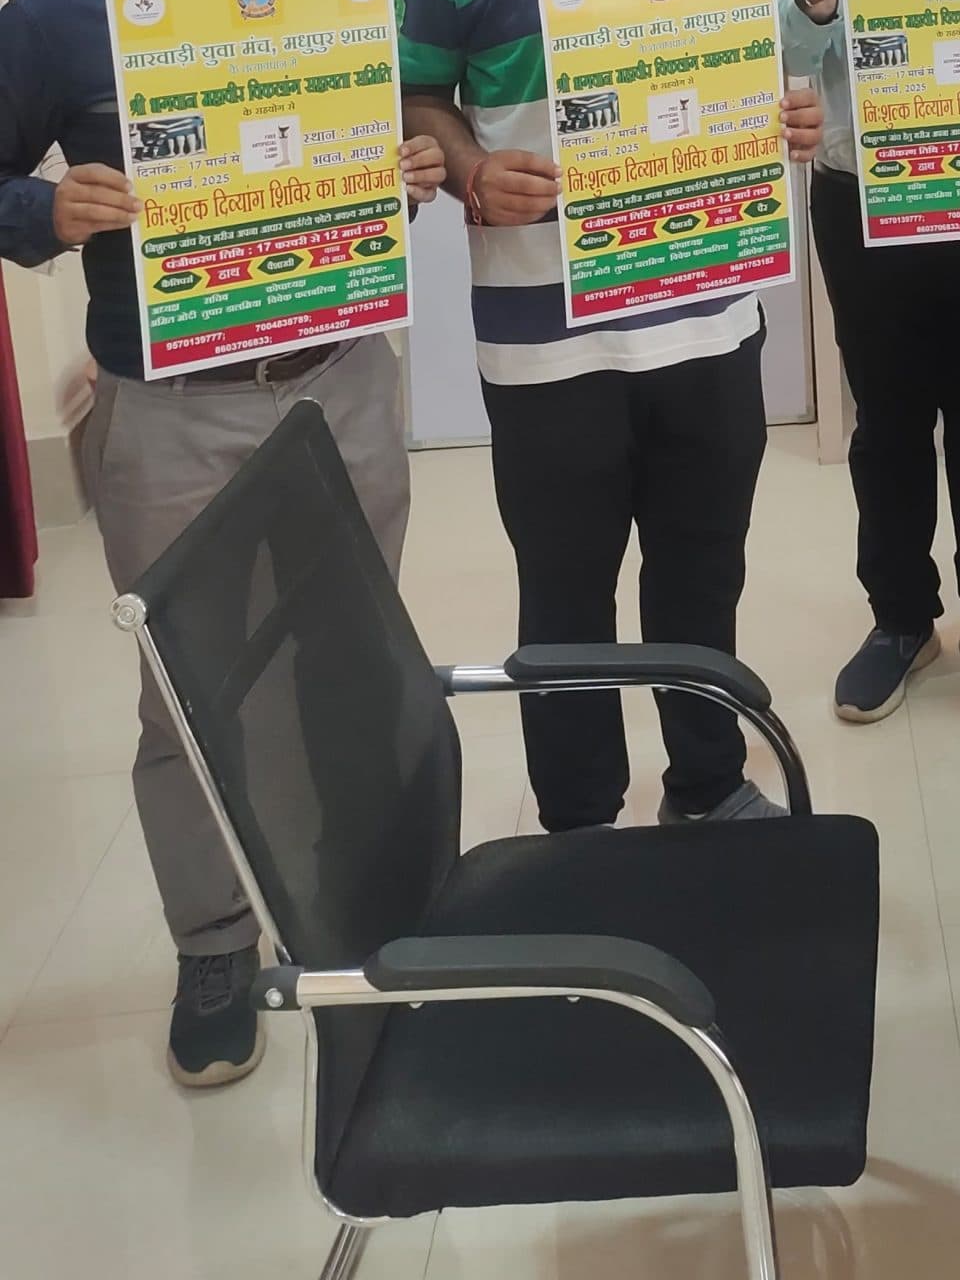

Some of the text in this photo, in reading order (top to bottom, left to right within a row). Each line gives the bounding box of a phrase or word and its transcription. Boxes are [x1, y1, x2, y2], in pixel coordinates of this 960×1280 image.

[551, 4, 773, 52] मारवाड़ी युवा मंच, मधुपुर शाखा
[123, 24, 387, 69] मारवाड़ी युवा मंच, मधुपुर शाखा
[303, 129, 335, 143] स्थान
[349, 119, 390, 137] अग्रसेन
[311, 144, 384, 165] भवन, मधुपुर
[575, 142, 639, 162] 19 मार्च, 2025
[623, 152, 668, 183] दिव्यांग
[670, 143, 707, 174] शिविर
[709, 144, 729, 166] का
[732, 132, 780, 162] आयोजन
[152, 172, 230, 193] 19 मार्च, 2025
[212, 184, 265, 218] दिव्यांग
[268, 175, 311, 208] शिविर
[314, 177, 336, 200] का
[340, 164, 396, 196] आयोजन
[165, 253, 217, 269] पंजीकरण
[218, 247, 245, 260] तिथि
[256, 241, 270, 253] 17
[274, 235, 308, 250] फरवरी
[309, 232, 321, 243] से
[323, 229, 339, 241] 12
[341, 224, 362, 238] मार्च
[363, 223, 384, 233] तक
[217, 266, 240, 280] हाथ
